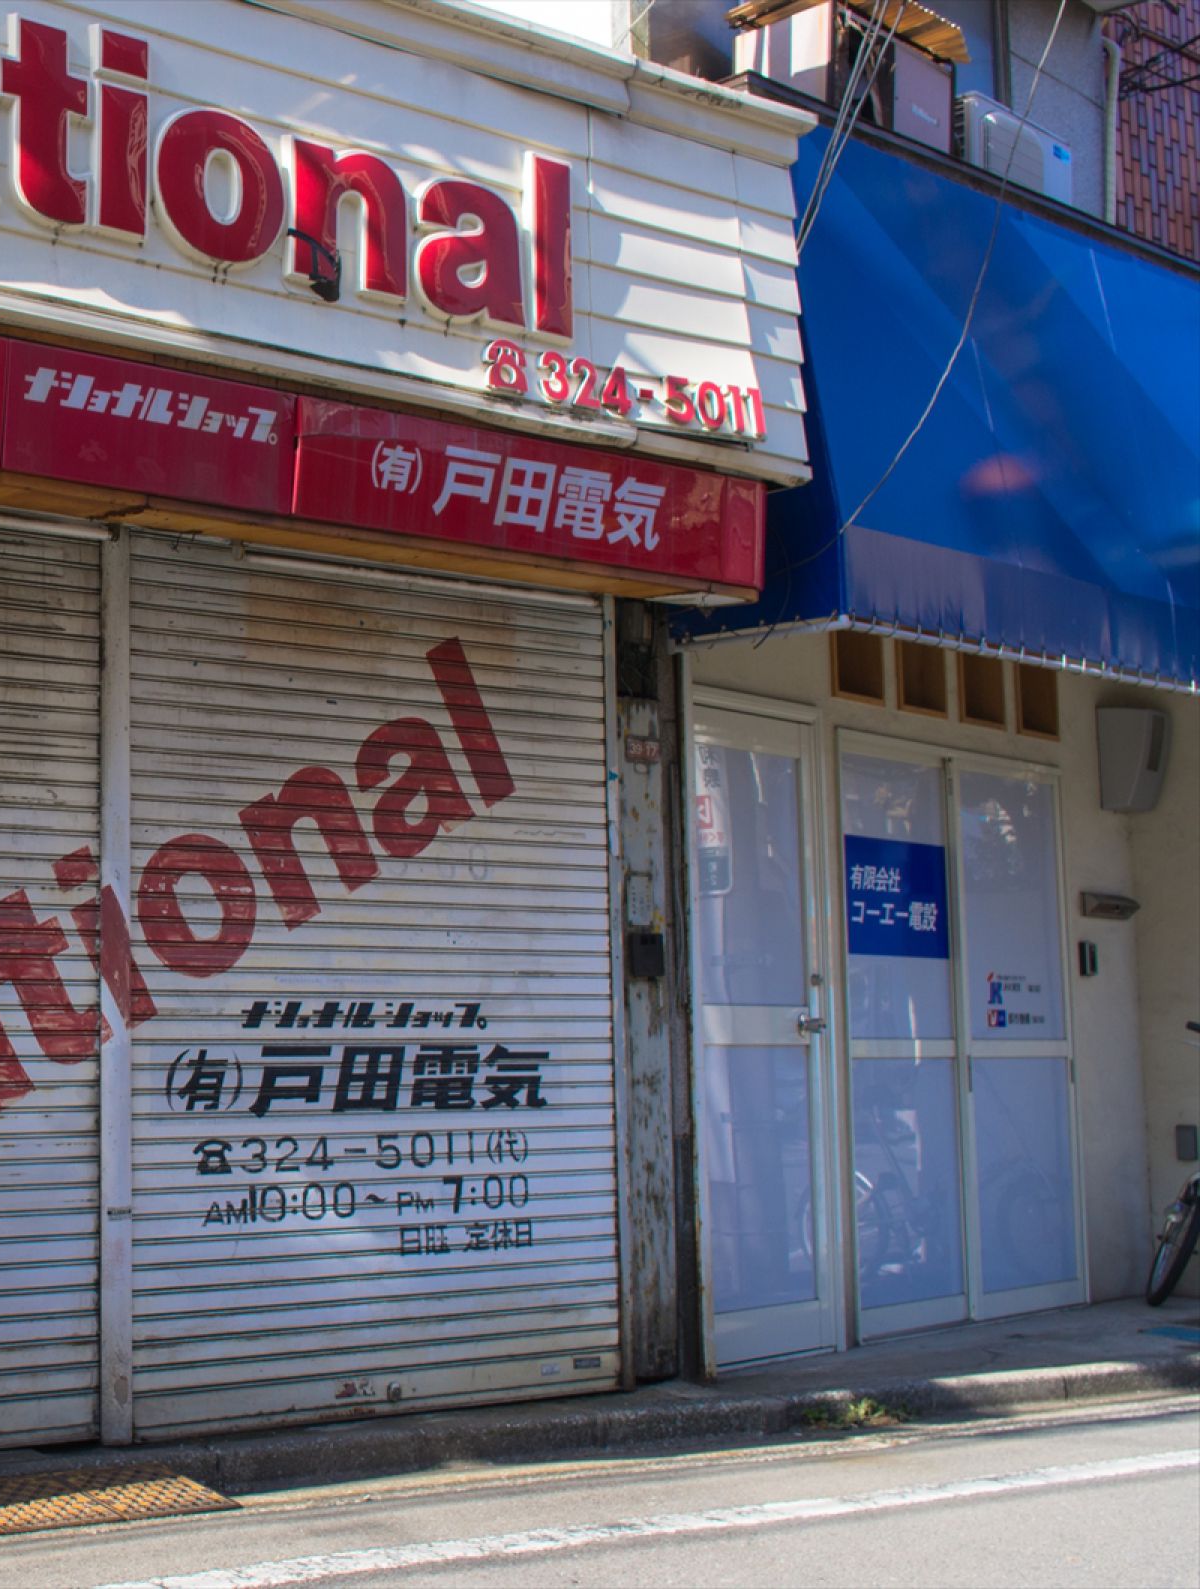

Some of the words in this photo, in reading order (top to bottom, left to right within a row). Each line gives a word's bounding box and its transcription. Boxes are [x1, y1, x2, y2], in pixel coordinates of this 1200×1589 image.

[538, 349, 767, 440] 324-5011
[849, 864, 901, 893] 有限会社
[851, 900, 939, 932] コーエー電設
[443, 1173, 529, 1215] 7:00
